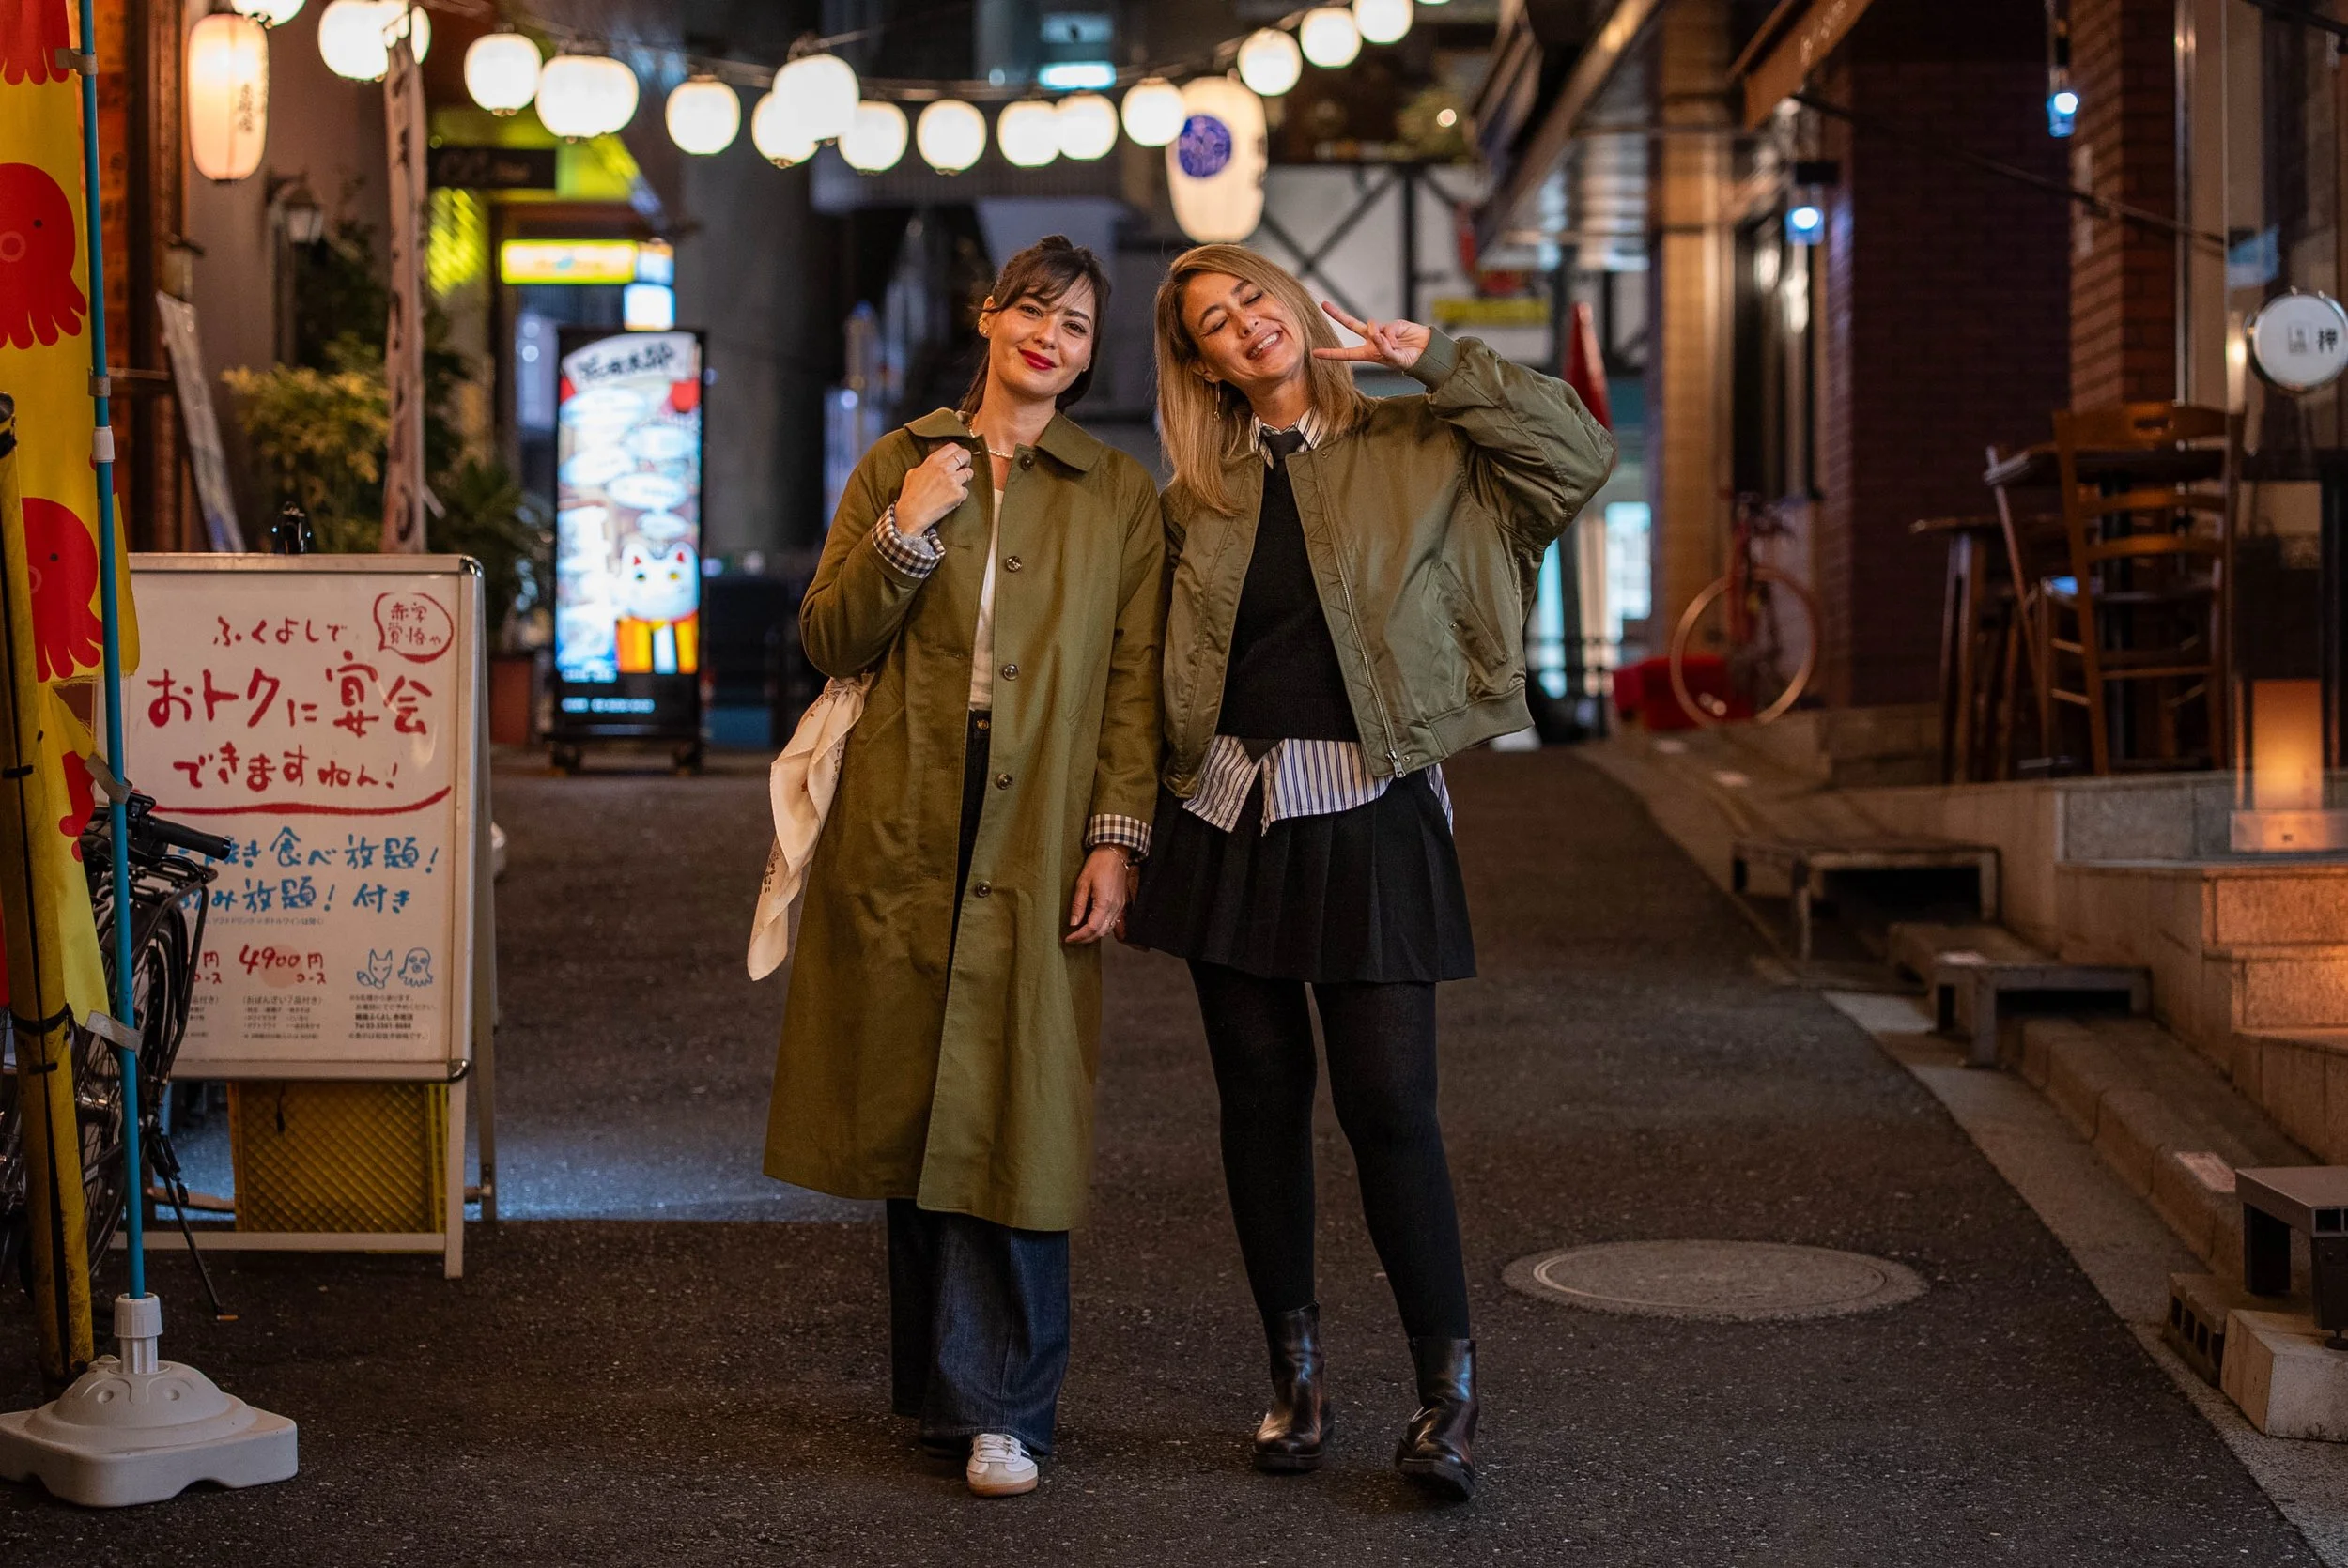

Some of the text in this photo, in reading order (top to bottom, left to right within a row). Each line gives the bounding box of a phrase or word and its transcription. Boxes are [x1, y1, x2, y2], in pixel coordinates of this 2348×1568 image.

[213, 616, 347, 647] ふくよしで
[147, 650, 432, 737] おトクに宴会
